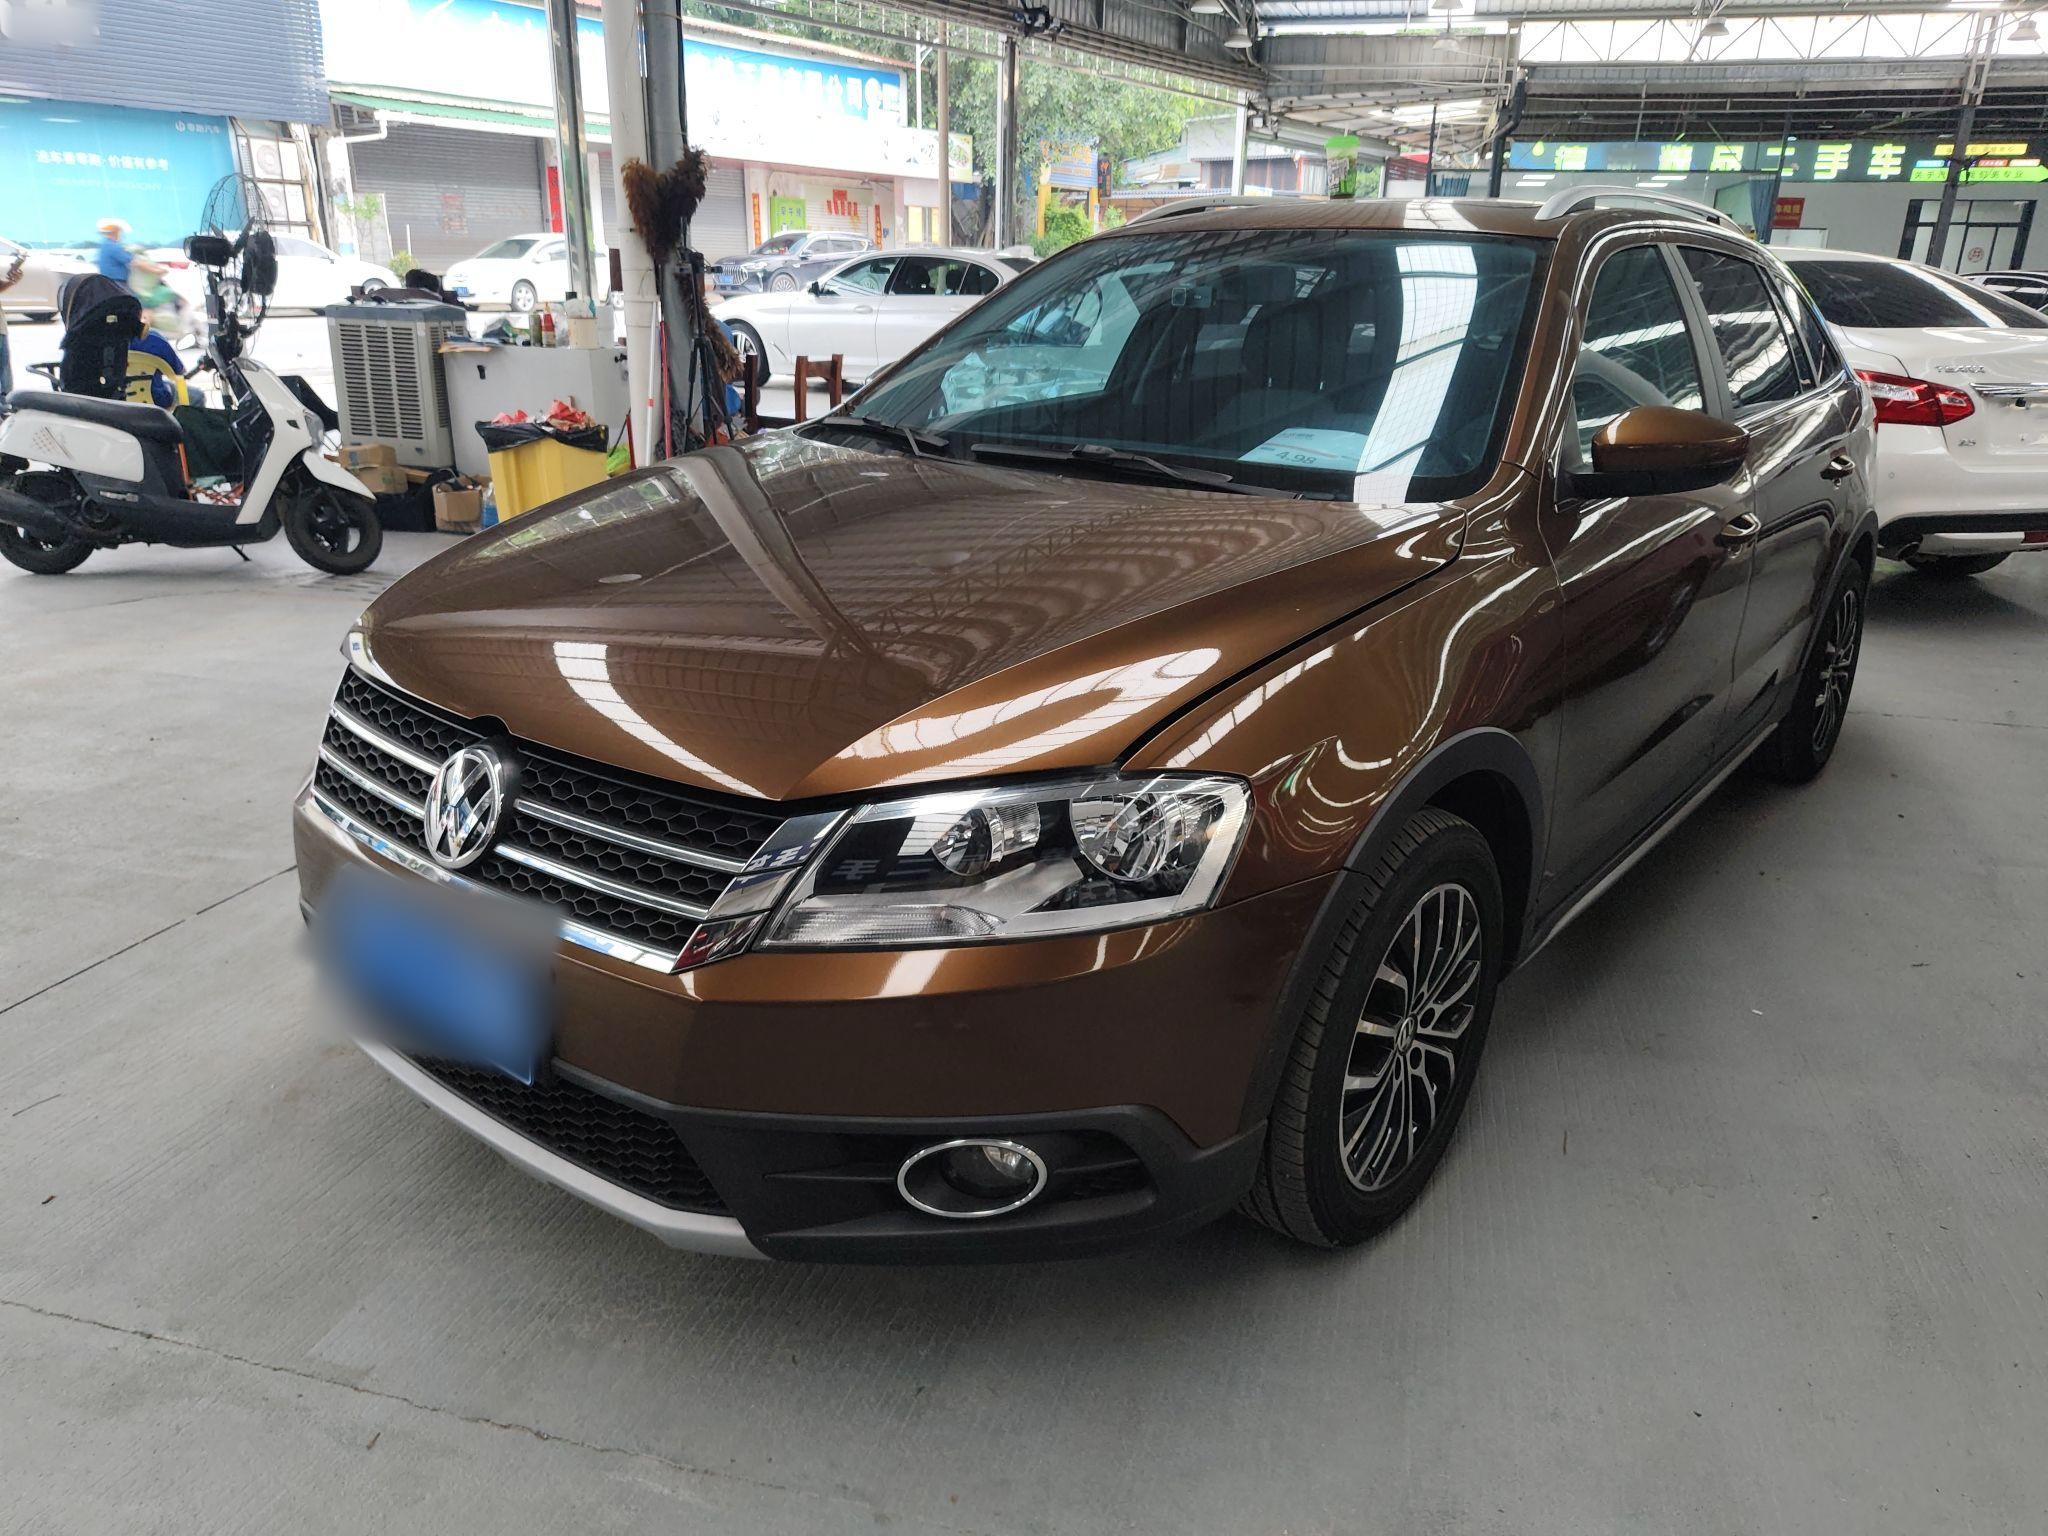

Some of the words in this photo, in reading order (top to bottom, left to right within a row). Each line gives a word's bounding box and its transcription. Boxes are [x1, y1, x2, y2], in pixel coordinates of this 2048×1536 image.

[1554, 143, 1906, 180] 德精品二手车
[1276, 451, 1317, 464] 4.98
